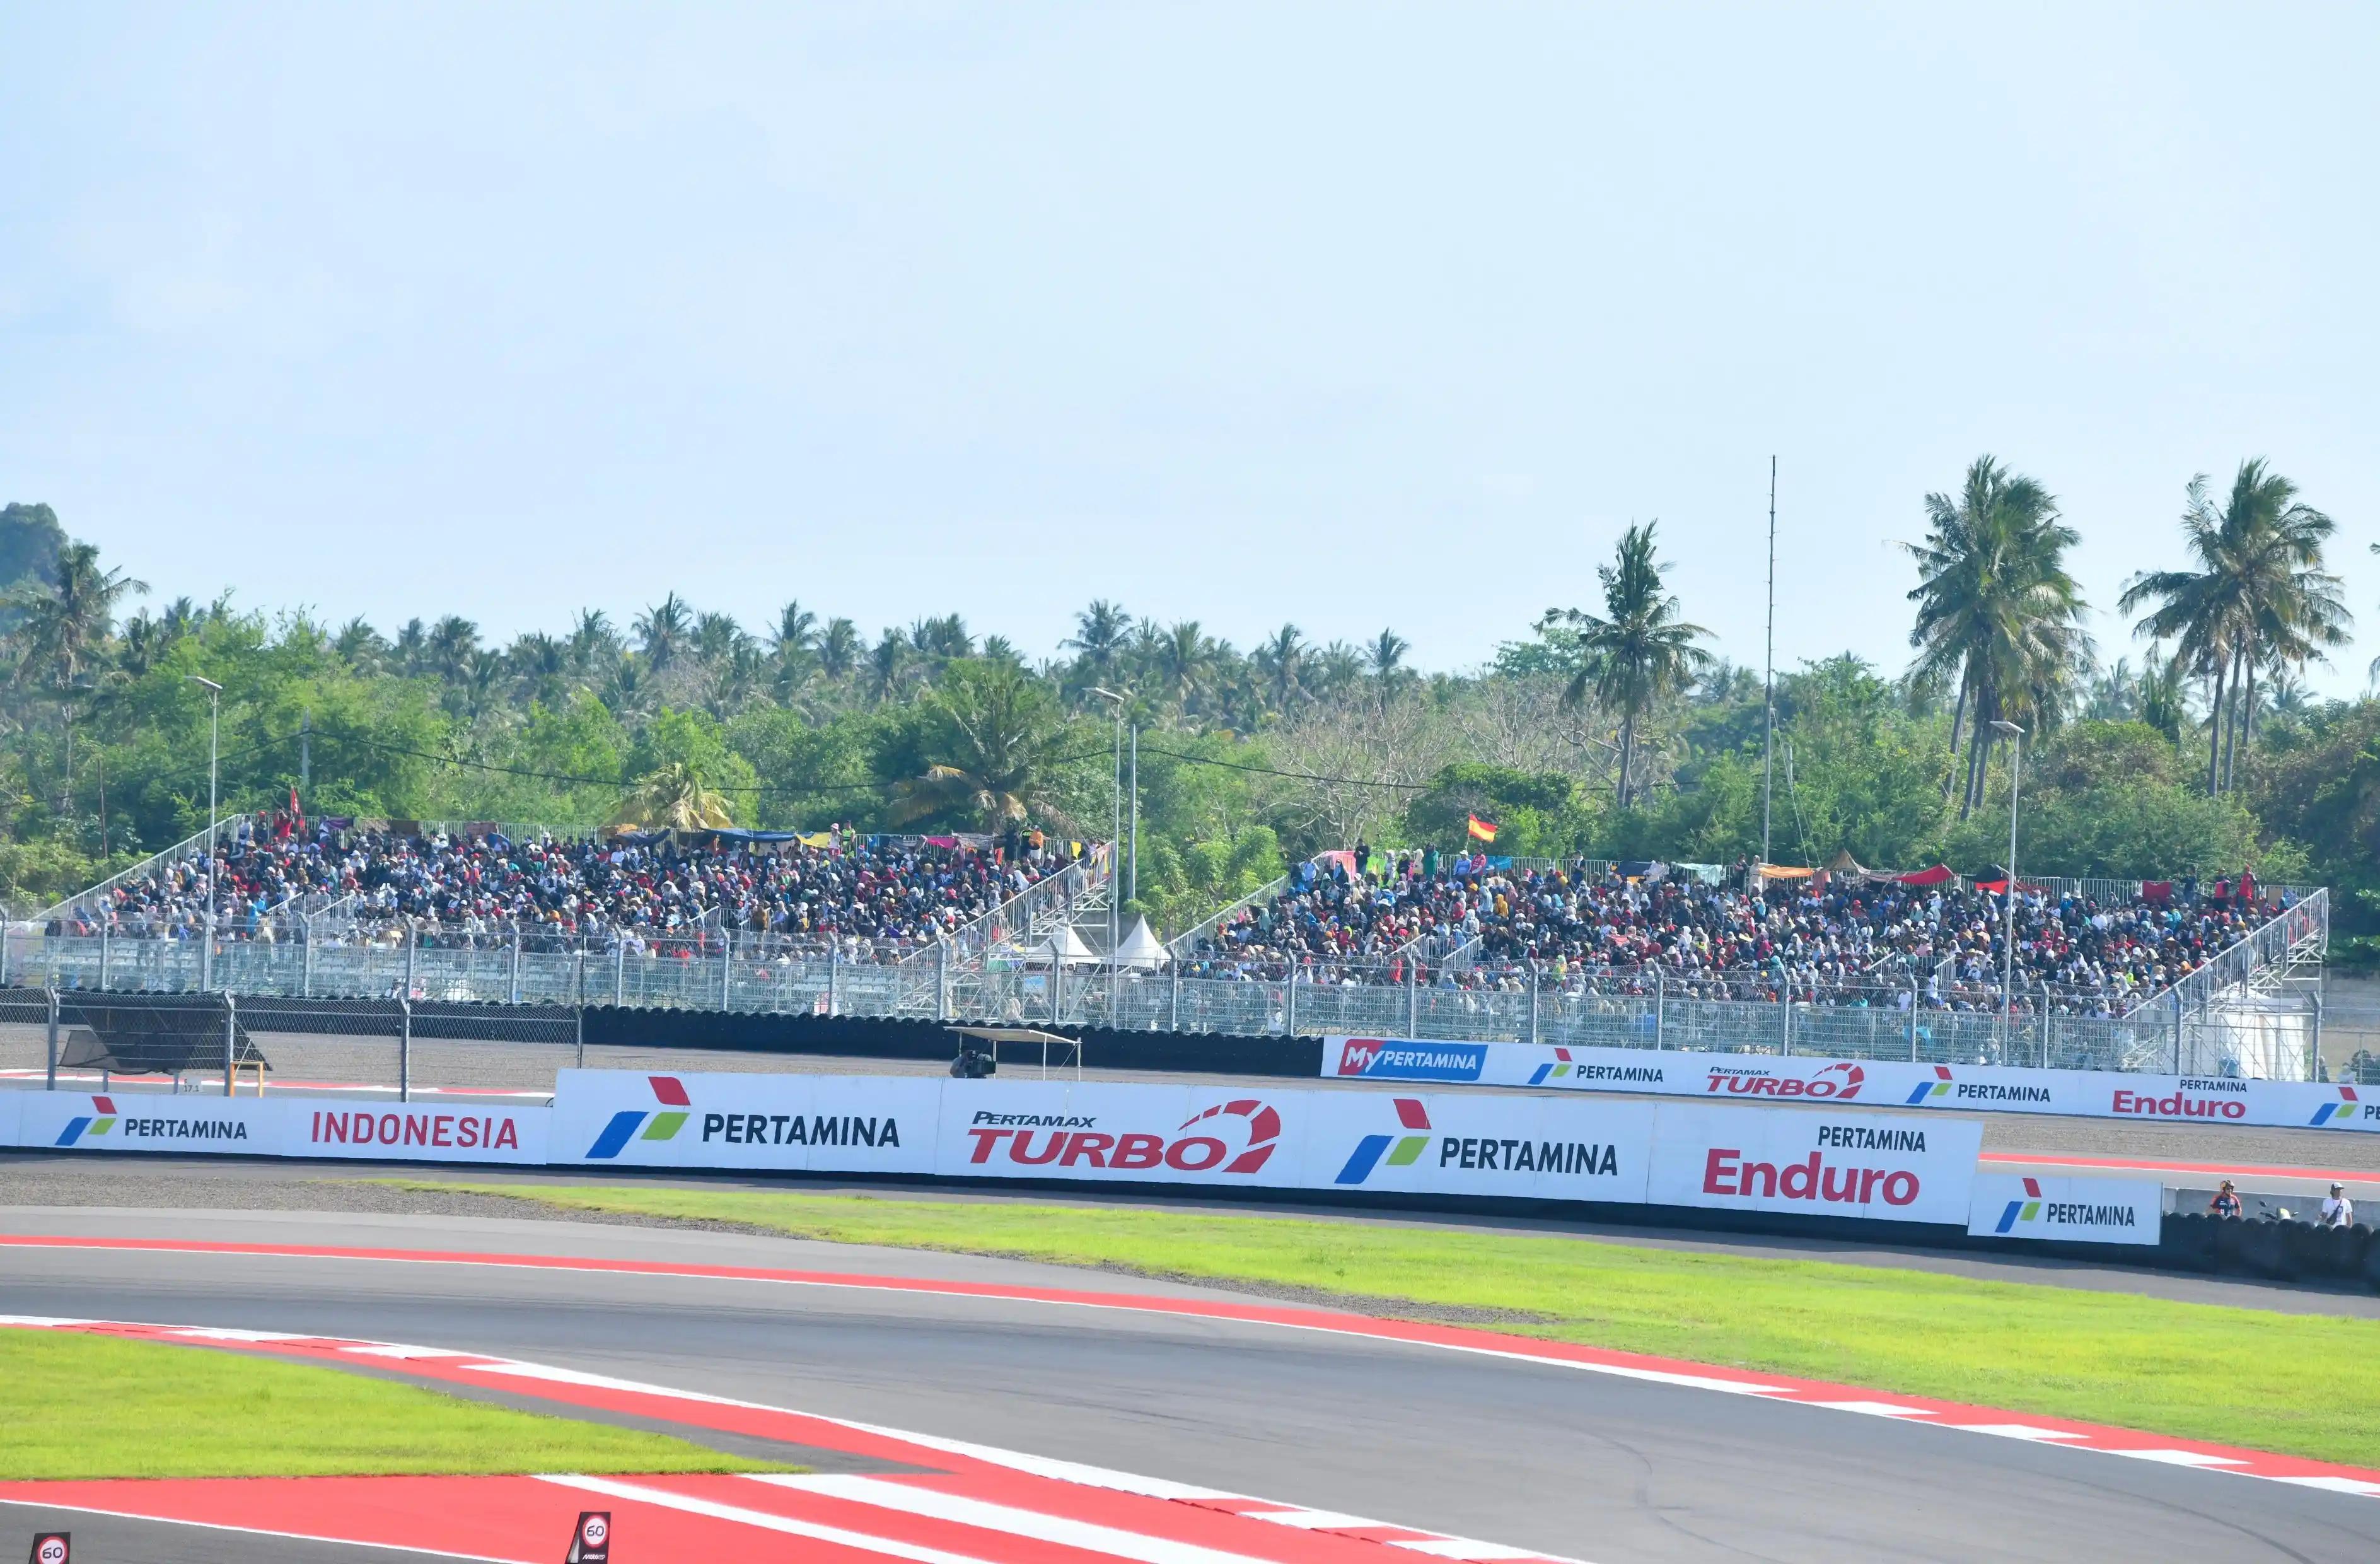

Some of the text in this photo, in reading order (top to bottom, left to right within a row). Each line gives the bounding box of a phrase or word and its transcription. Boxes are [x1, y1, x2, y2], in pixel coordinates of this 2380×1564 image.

[1345, 1046, 1477, 1073] MyPERTAMINA
[1709, 1066, 1770, 1076] PERTAMAX
[1576, 1065, 1664, 1083] PERTAMINA
[2180, 1079, 2248, 1092] PERTAMINA
[1706, 1075, 1838, 1098] TURBO
[1958, 1083, 2052, 1103] PERTAMINA
[2112, 1090, 2246, 1119] Enduro
[124, 1118, 248, 1140] PERTAMINA
[311, 1111, 519, 1150] INDONESIA
[702, 1113, 900, 1148] PERTAMINA
[972, 1111, 1098, 1129] PERTAMAX
[967, 1128, 1228, 1172] TURBO
[1818, 1126, 1927, 1153] PERTAMINA
[1439, 1137, 1618, 1176] PERTAMINA
[1702, 1148, 1920, 1206] Enduro
[2046, 1203, 2136, 1227] PERTAMINA
[587, 1525, 604, 1536] 60
[42, 1547, 62, 1559] 60
